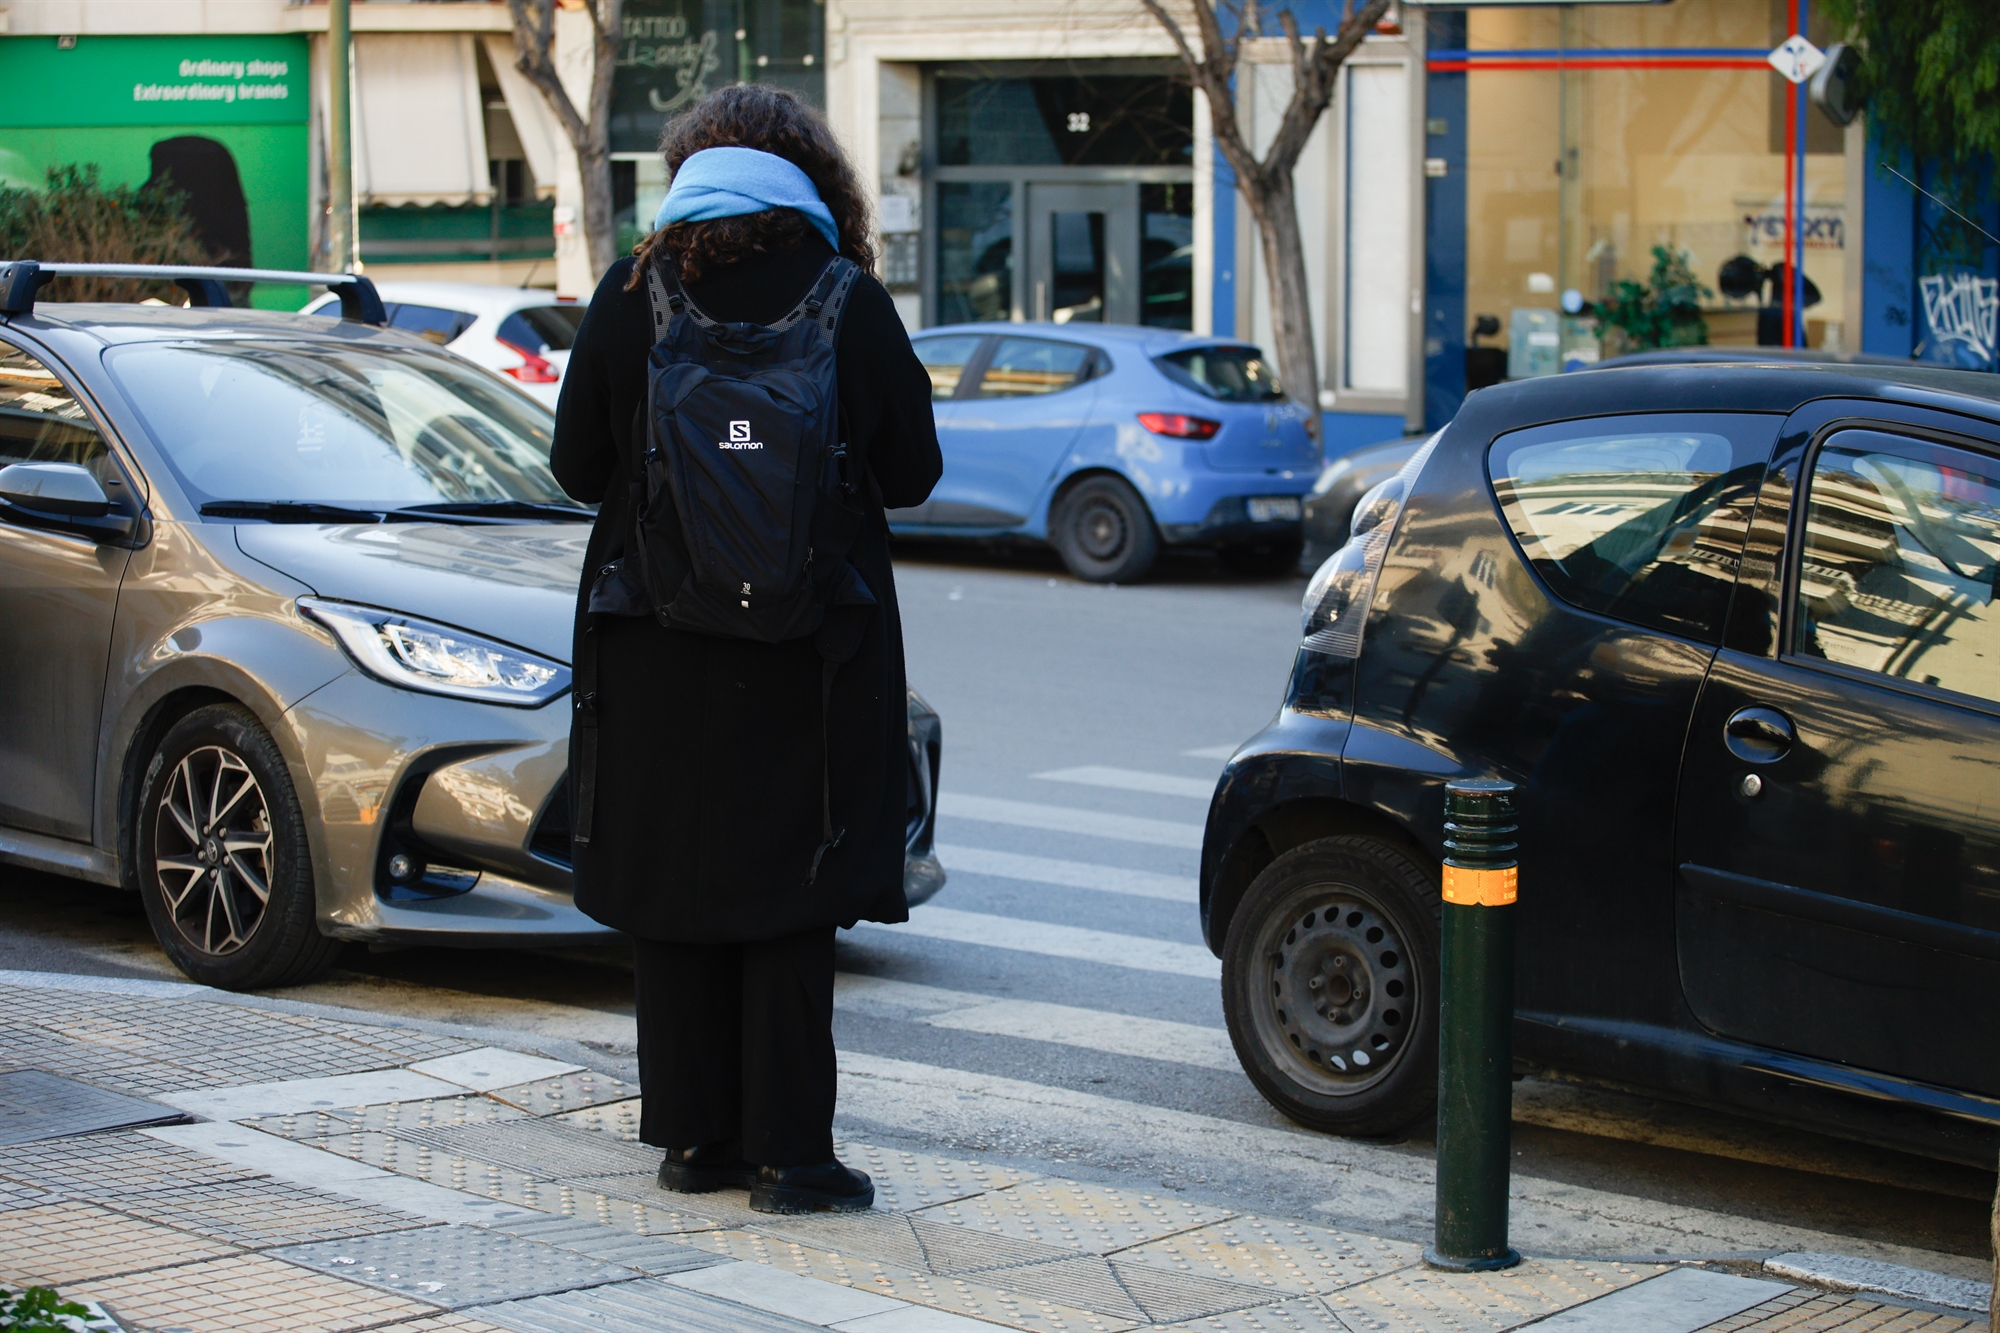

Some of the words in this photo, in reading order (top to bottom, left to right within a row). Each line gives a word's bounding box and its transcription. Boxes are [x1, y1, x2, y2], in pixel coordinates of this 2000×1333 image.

[622, 16, 687, 39] TATTOO
[179, 58, 245, 79] Ordinary
[246, 58, 288, 79] shops
[133, 82, 236, 103] Extraordinary
[237, 82, 288, 100] brands
[1067, 112, 1090, 132] 32
[743, 582, 751, 592] 30
